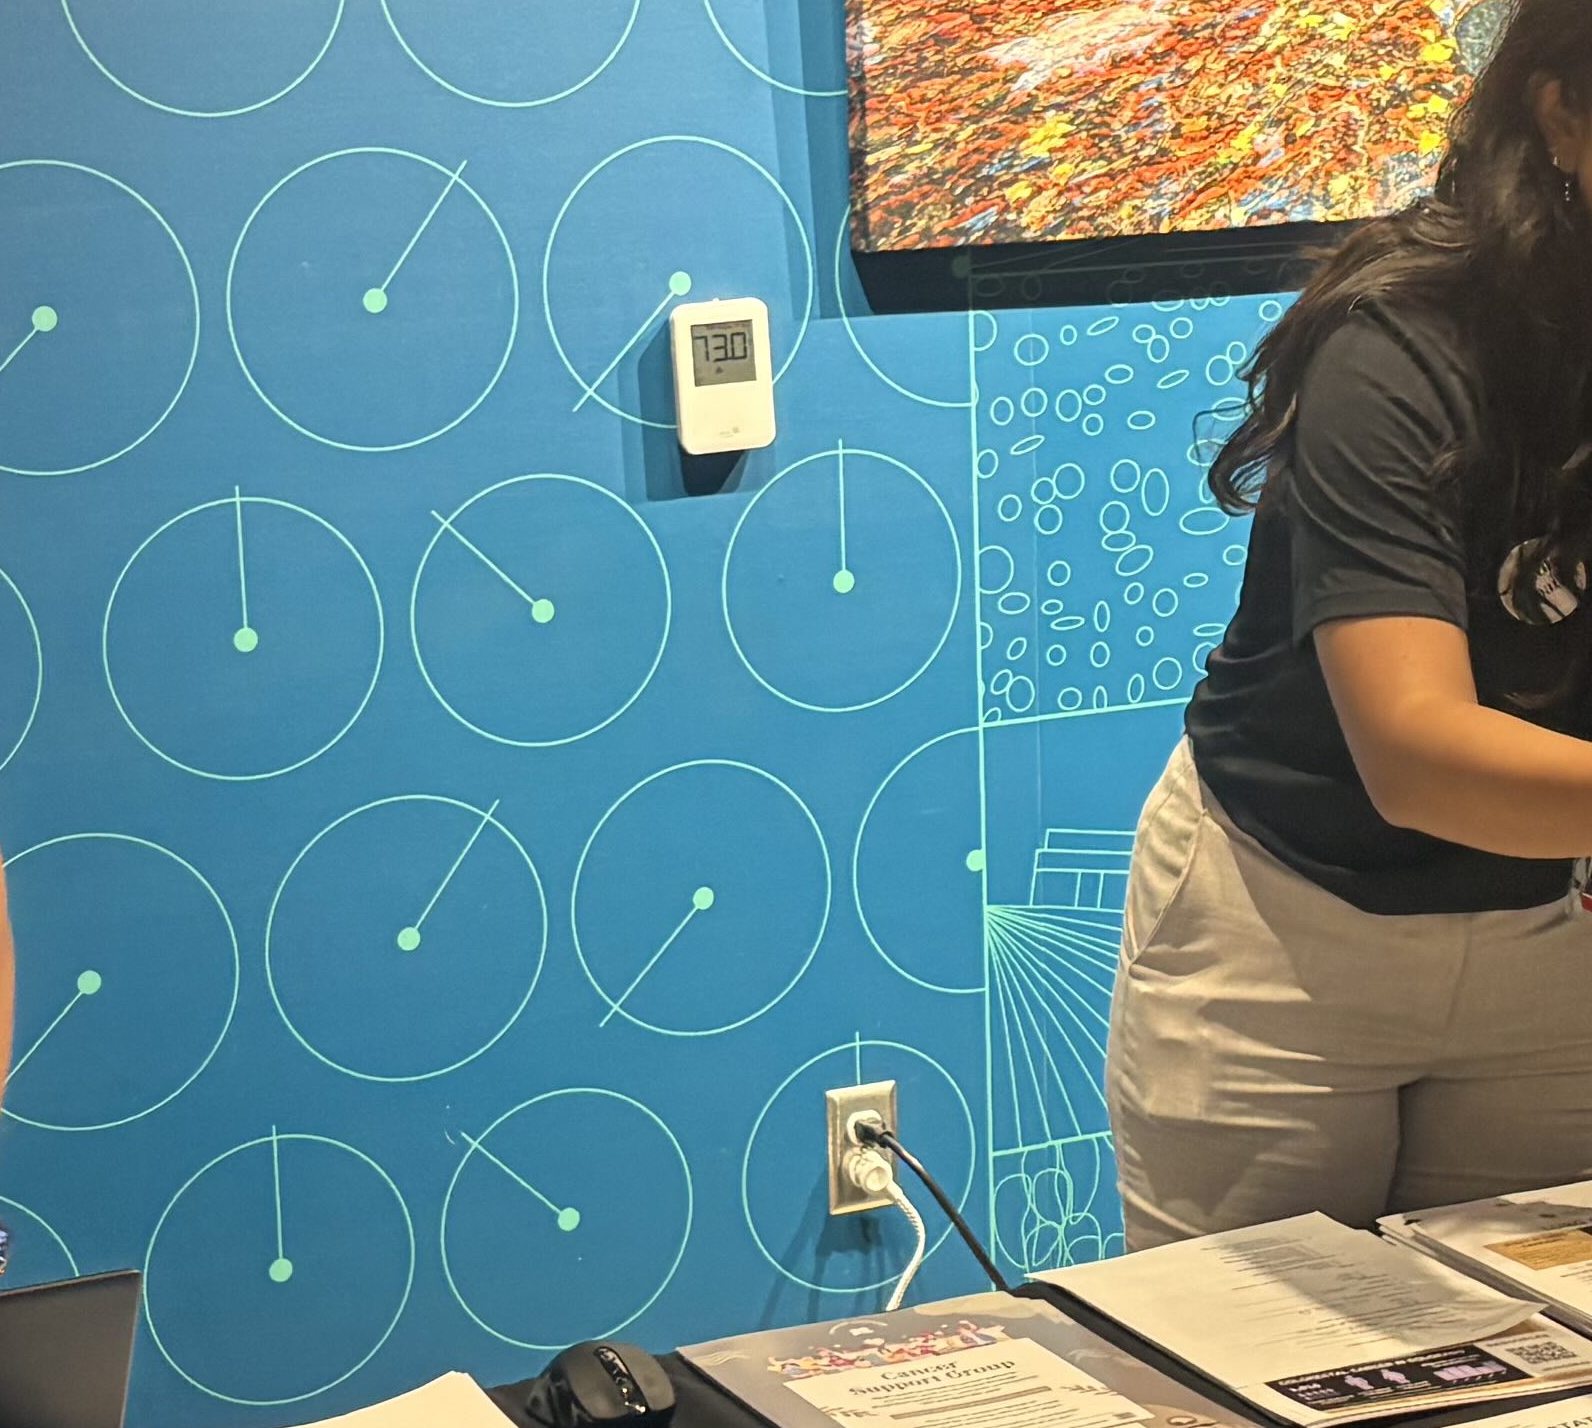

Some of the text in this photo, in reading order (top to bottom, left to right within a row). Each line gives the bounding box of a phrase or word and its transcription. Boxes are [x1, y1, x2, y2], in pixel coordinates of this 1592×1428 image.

[849, 1357, 1016, 1397] Support Group
[881, 1360, 959, 1382] Cancer
